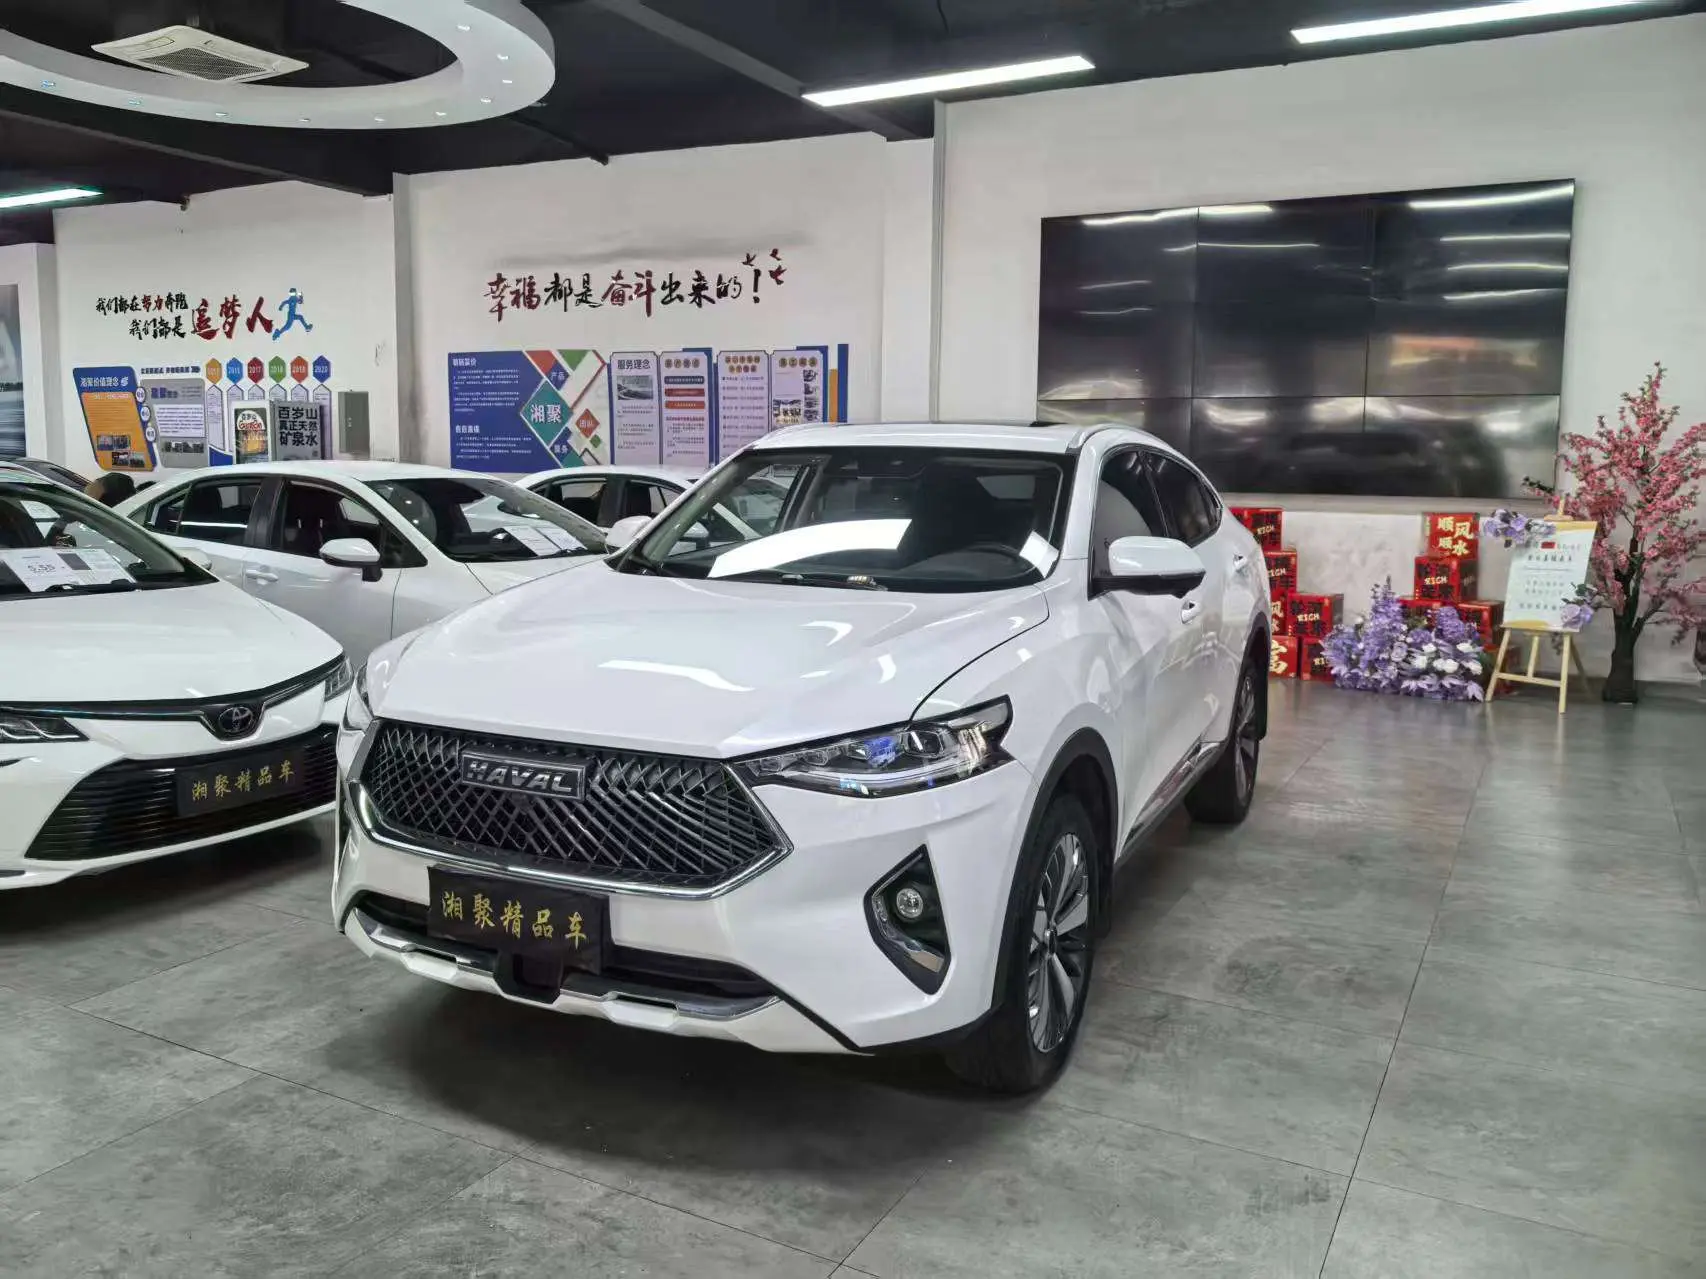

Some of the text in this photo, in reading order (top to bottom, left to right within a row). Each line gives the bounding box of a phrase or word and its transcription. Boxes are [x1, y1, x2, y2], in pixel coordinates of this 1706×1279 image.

[95, 292, 188, 316] 我们都在努力奔跑
[129, 315, 185, 340] 我们都是
[191, 294, 274, 341] 追梦人
[278, 406, 317, 420] 百岁山
[278, 420, 318, 431] 真正天然
[279, 431, 318, 446] 矿泉水
[191, 759, 295, 802] 湘聚精品车
[466, 759, 573, 793] HAVAL
[441, 890, 588, 950] 湘聚精品车
